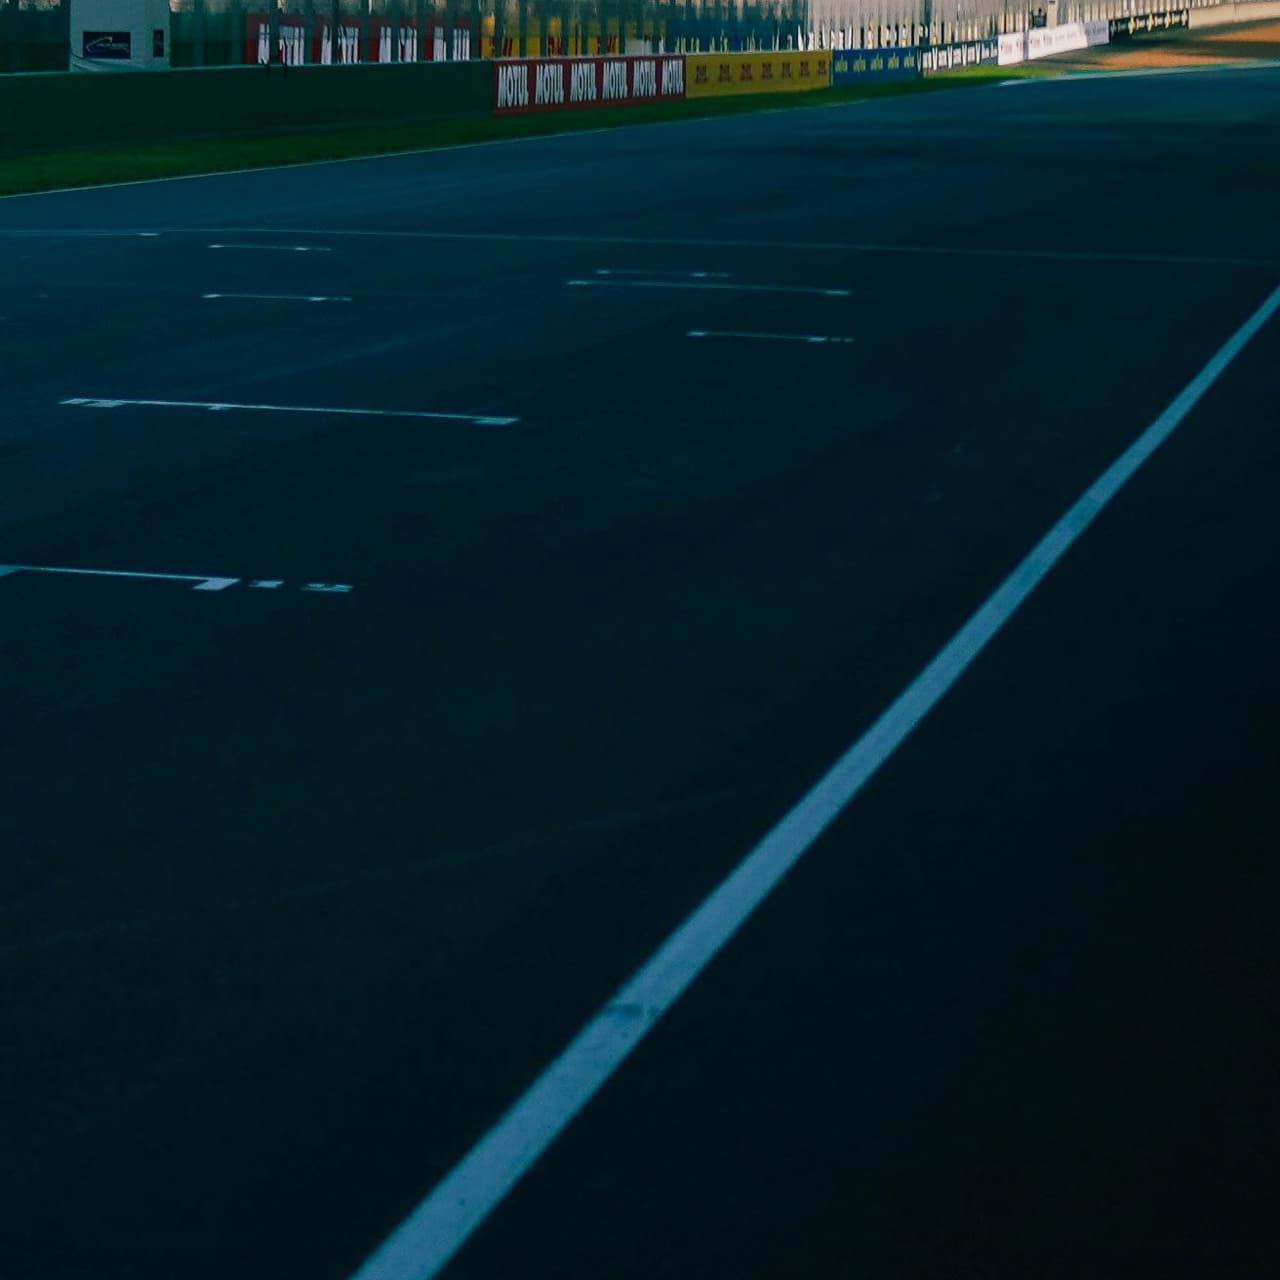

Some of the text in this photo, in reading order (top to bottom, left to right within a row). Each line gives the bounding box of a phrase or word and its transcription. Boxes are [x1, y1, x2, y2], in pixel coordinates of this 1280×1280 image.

[498, 65, 528, 107] MOTUL
[535, 64, 564, 104] MOTUL
[570, 62, 597, 102] MOTUL
[602, 61, 627, 99] MOTUL
[633, 60, 656, 97] MOTUL
[661, 58, 683, 95] MOTUL
